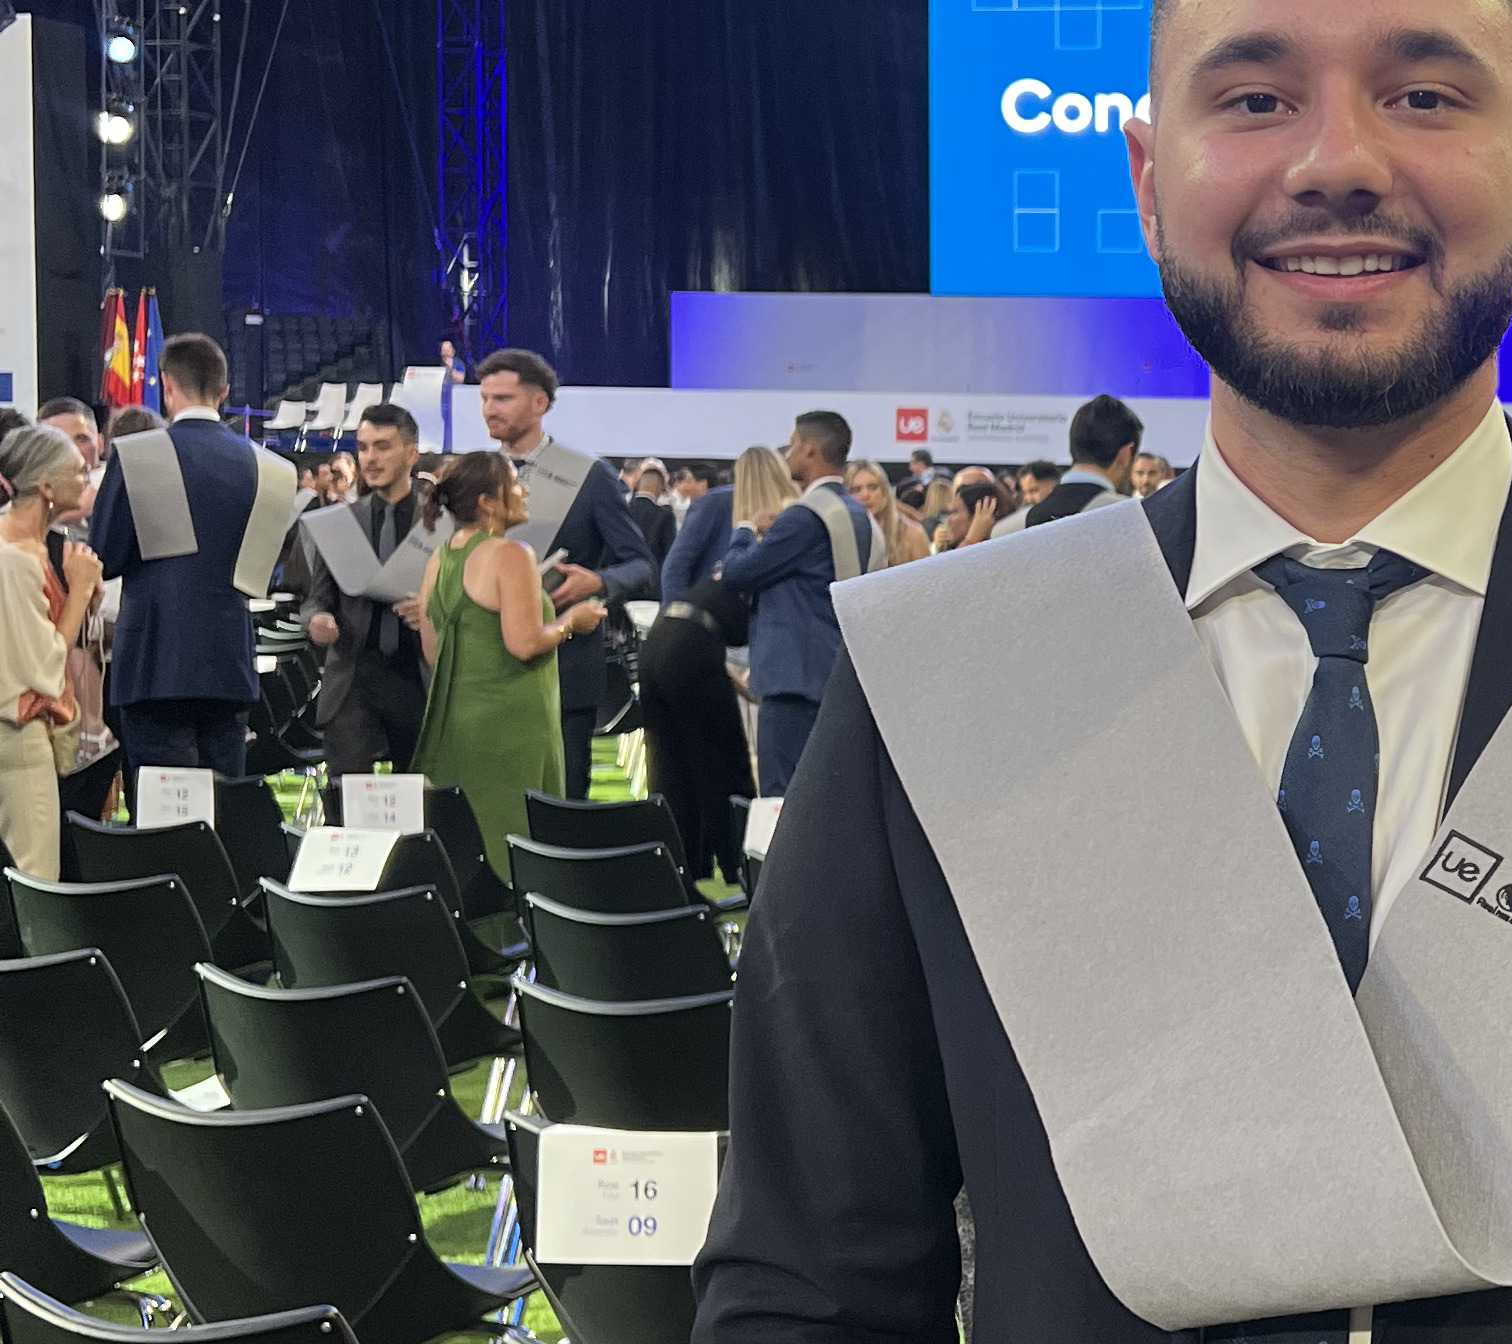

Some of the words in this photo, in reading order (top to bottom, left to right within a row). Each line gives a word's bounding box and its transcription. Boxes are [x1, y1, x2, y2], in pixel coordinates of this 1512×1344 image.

[1441, 851, 1480, 882] ue
[630, 1179, 658, 1201] 16
[628, 1215, 657, 1237] 09
